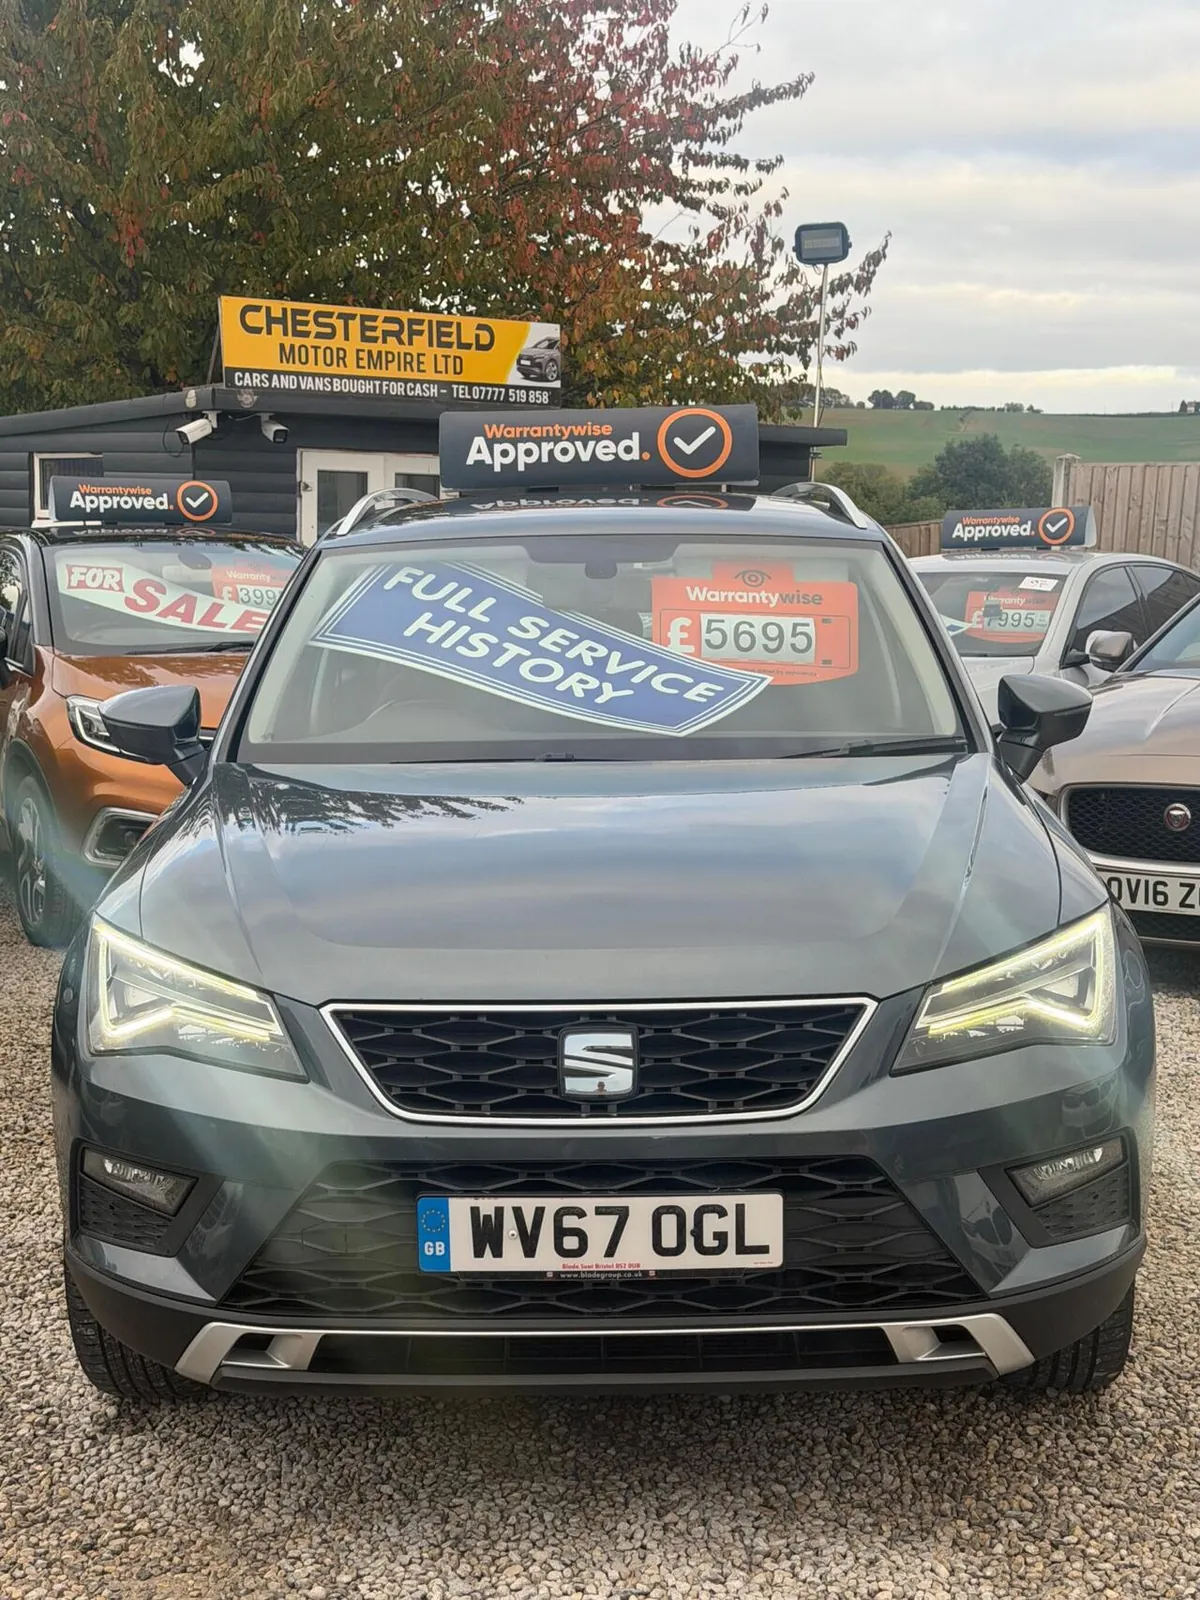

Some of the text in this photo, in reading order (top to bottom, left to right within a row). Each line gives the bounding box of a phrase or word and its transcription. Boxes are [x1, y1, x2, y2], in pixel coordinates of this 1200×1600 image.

[239, 304, 495, 352] CHESTERFIELD
[279, 343, 463, 376] MOTOR EMPIRE LTD
[234, 371, 269, 388] CARS
[271, 374, 297, 390] AND
[299, 375, 331, 392] VANS
[333, 378, 381, 395] BOUGHT
[382, 381, 405, 396] FOR
[406, 382, 438, 398] CASH
[451, 384, 471, 399] TEL
[472, 386, 506, 401] 07777
[508, 388, 526, 403] 519
[528, 390, 549, 404] 858
[483, 423, 613, 440] Warrantywise
[465, 431, 651, 472] Approved.
[69, 490, 174, 513] Approved.
[78, 484, 152, 495] Warrantywise
[952, 520, 1035, 541] Approved.
[962, 516, 1020, 525] Warrantywise
[69, 566, 121, 592] FOR
[124, 578, 270, 634] SALE
[222, 586, 282, 606] £399
[686, 586, 823, 608] Warrantywise
[383, 566, 725, 703] FULL SERVICE
[403, 612, 636, 705] HISTORY
[1106, 876, 1200, 909] OV16 Z
[423, 1203, 770, 1259] GB WV67 OGL
[560, 1271, 642, 1279] www.bladegroup.co.uk
